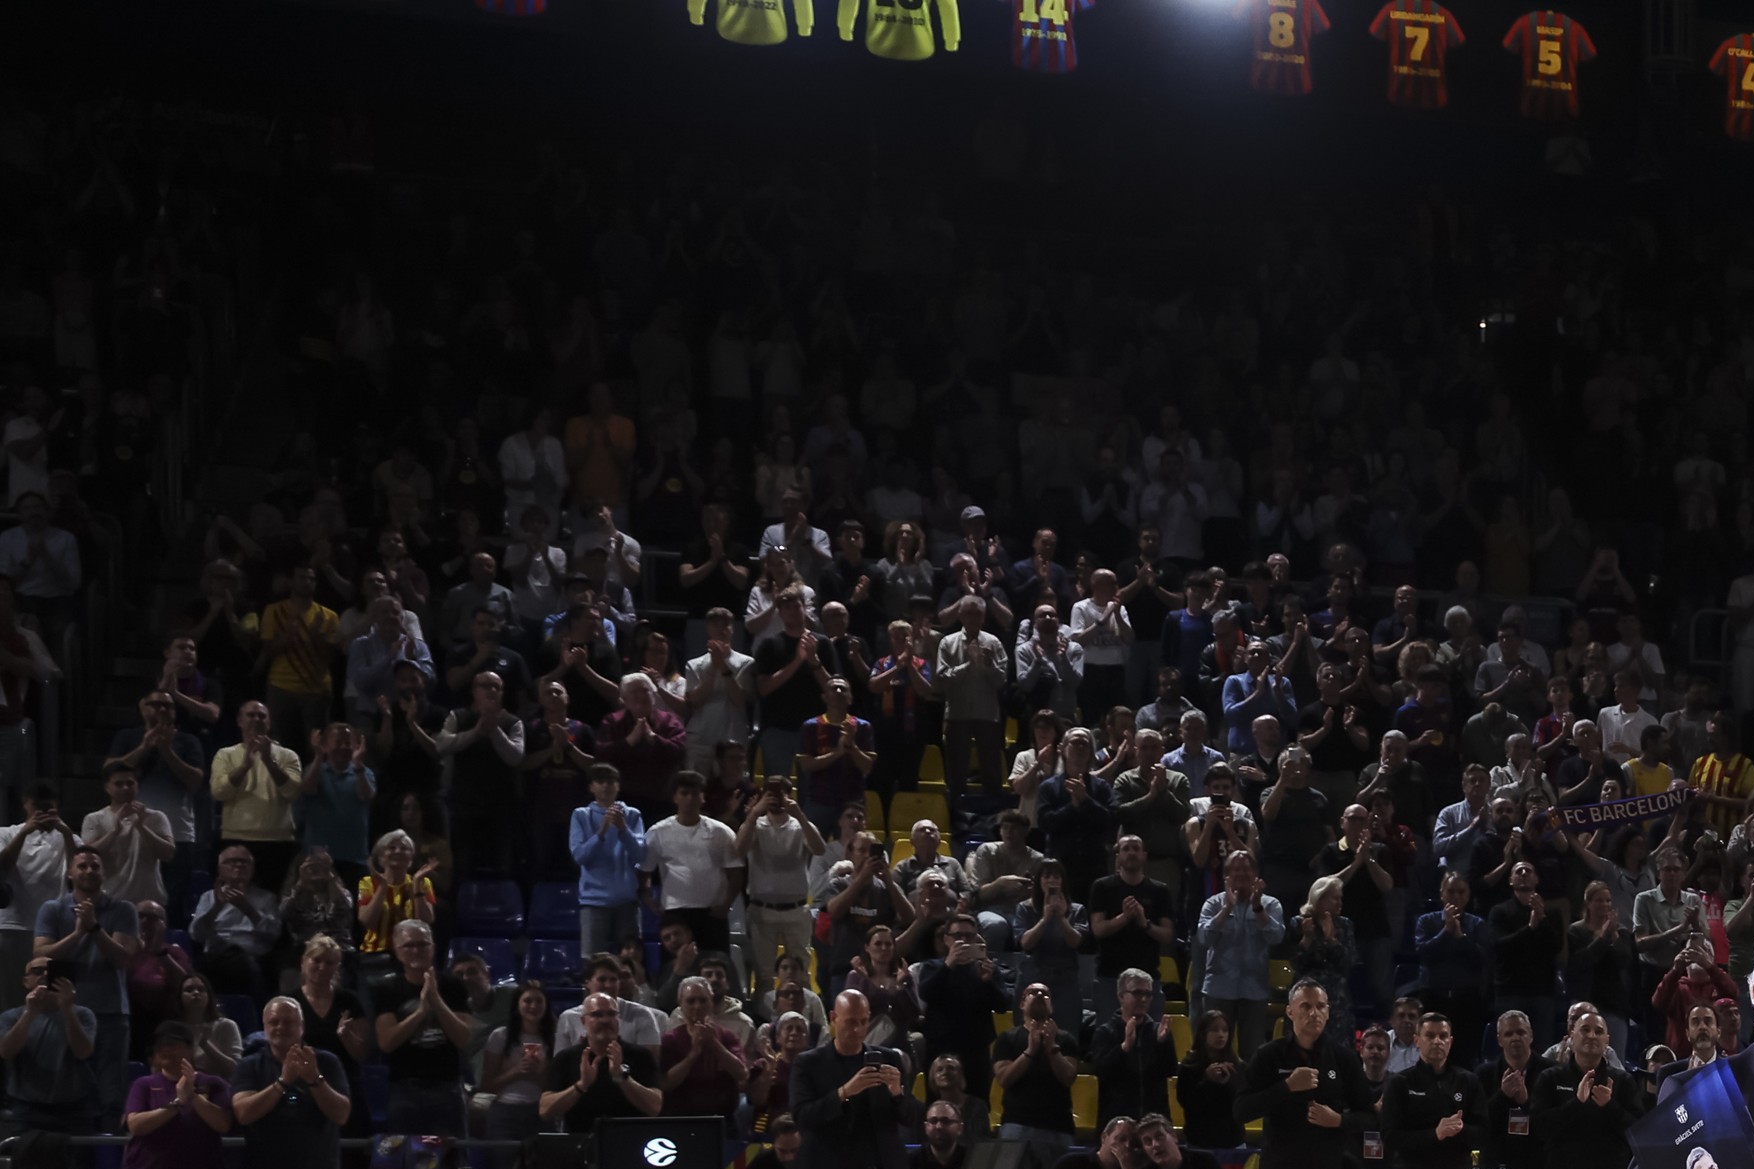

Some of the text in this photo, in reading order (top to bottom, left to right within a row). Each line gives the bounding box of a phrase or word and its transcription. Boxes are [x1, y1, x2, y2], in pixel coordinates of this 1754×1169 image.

[1268, 11, 1295, 48] 8
[1404, 26, 1431, 62] 7
[1537, 40, 1562, 75] 5
[1563, 808, 1587, 825] FC
